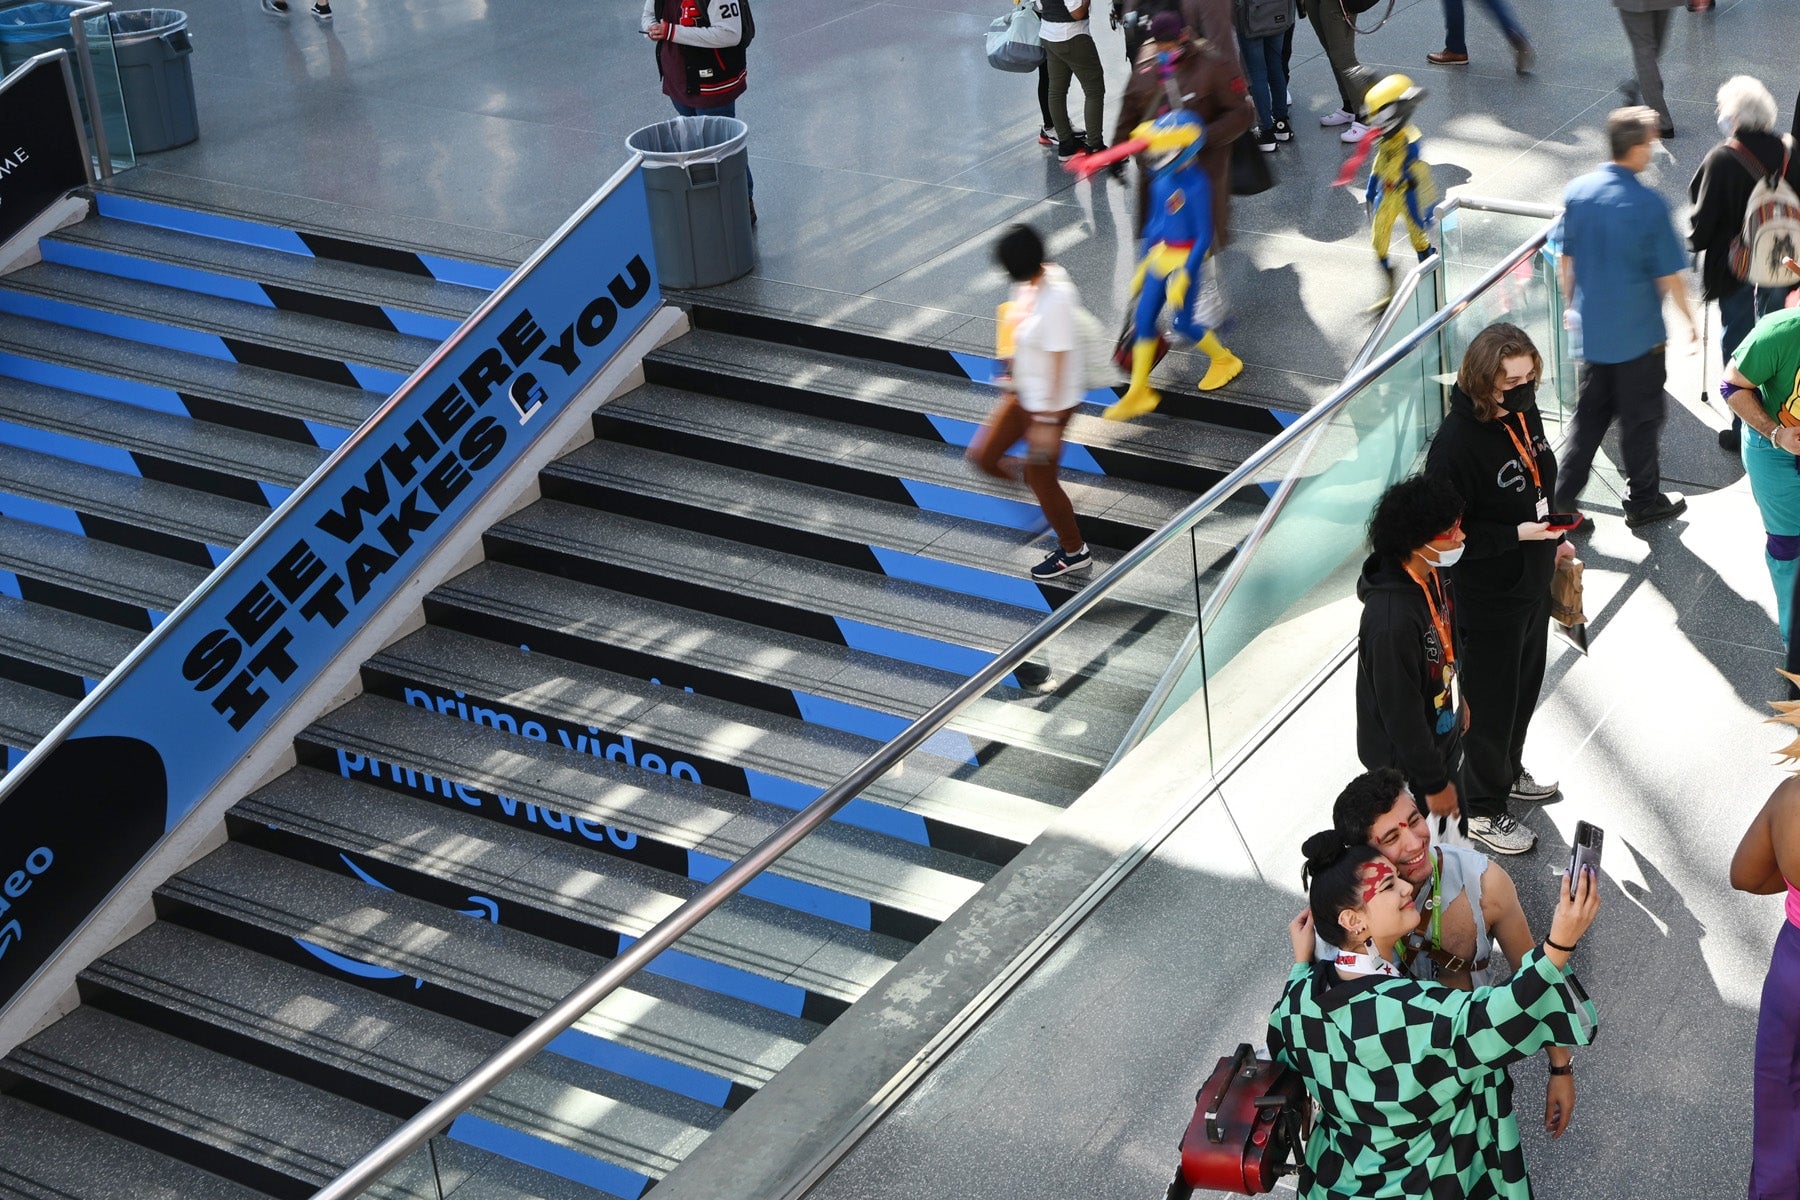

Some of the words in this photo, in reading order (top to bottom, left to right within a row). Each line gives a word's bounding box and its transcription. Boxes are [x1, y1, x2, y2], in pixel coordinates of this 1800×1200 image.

[720, 2, 739, 19] 20
[182, 538, 327, 692] SEE
[315, 308, 547, 545] WHERE
[211, 626, 299, 733] IT
[299, 415, 508, 629] TAKES
[538, 254, 652, 376] YOU
